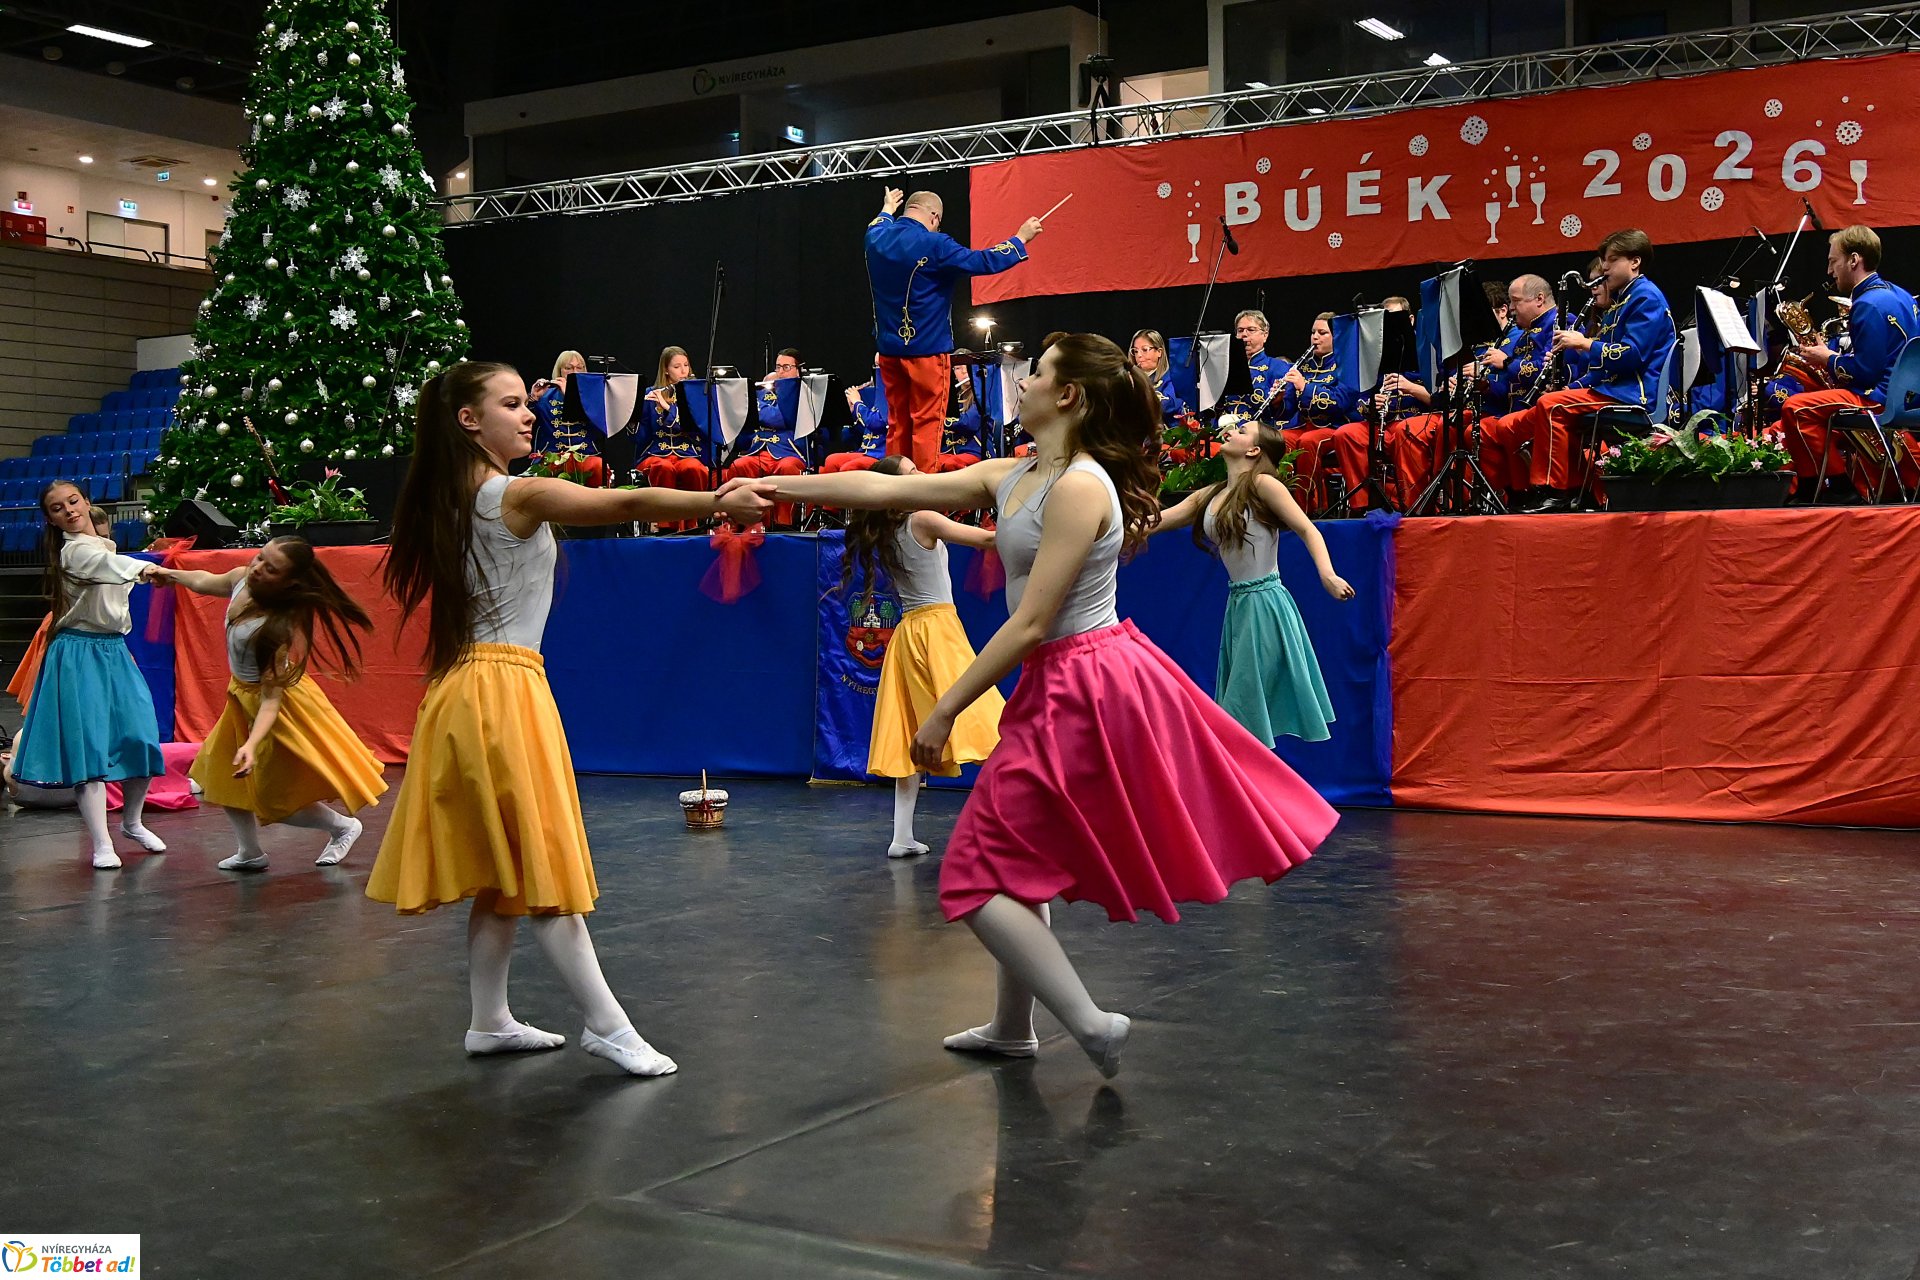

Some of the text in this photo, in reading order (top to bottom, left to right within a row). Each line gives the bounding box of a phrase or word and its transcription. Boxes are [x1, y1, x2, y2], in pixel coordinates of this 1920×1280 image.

[718, 66, 786, 85] NYÍREGYHÁZA
[1224, 130, 1826, 232] BÚÉK 2026
